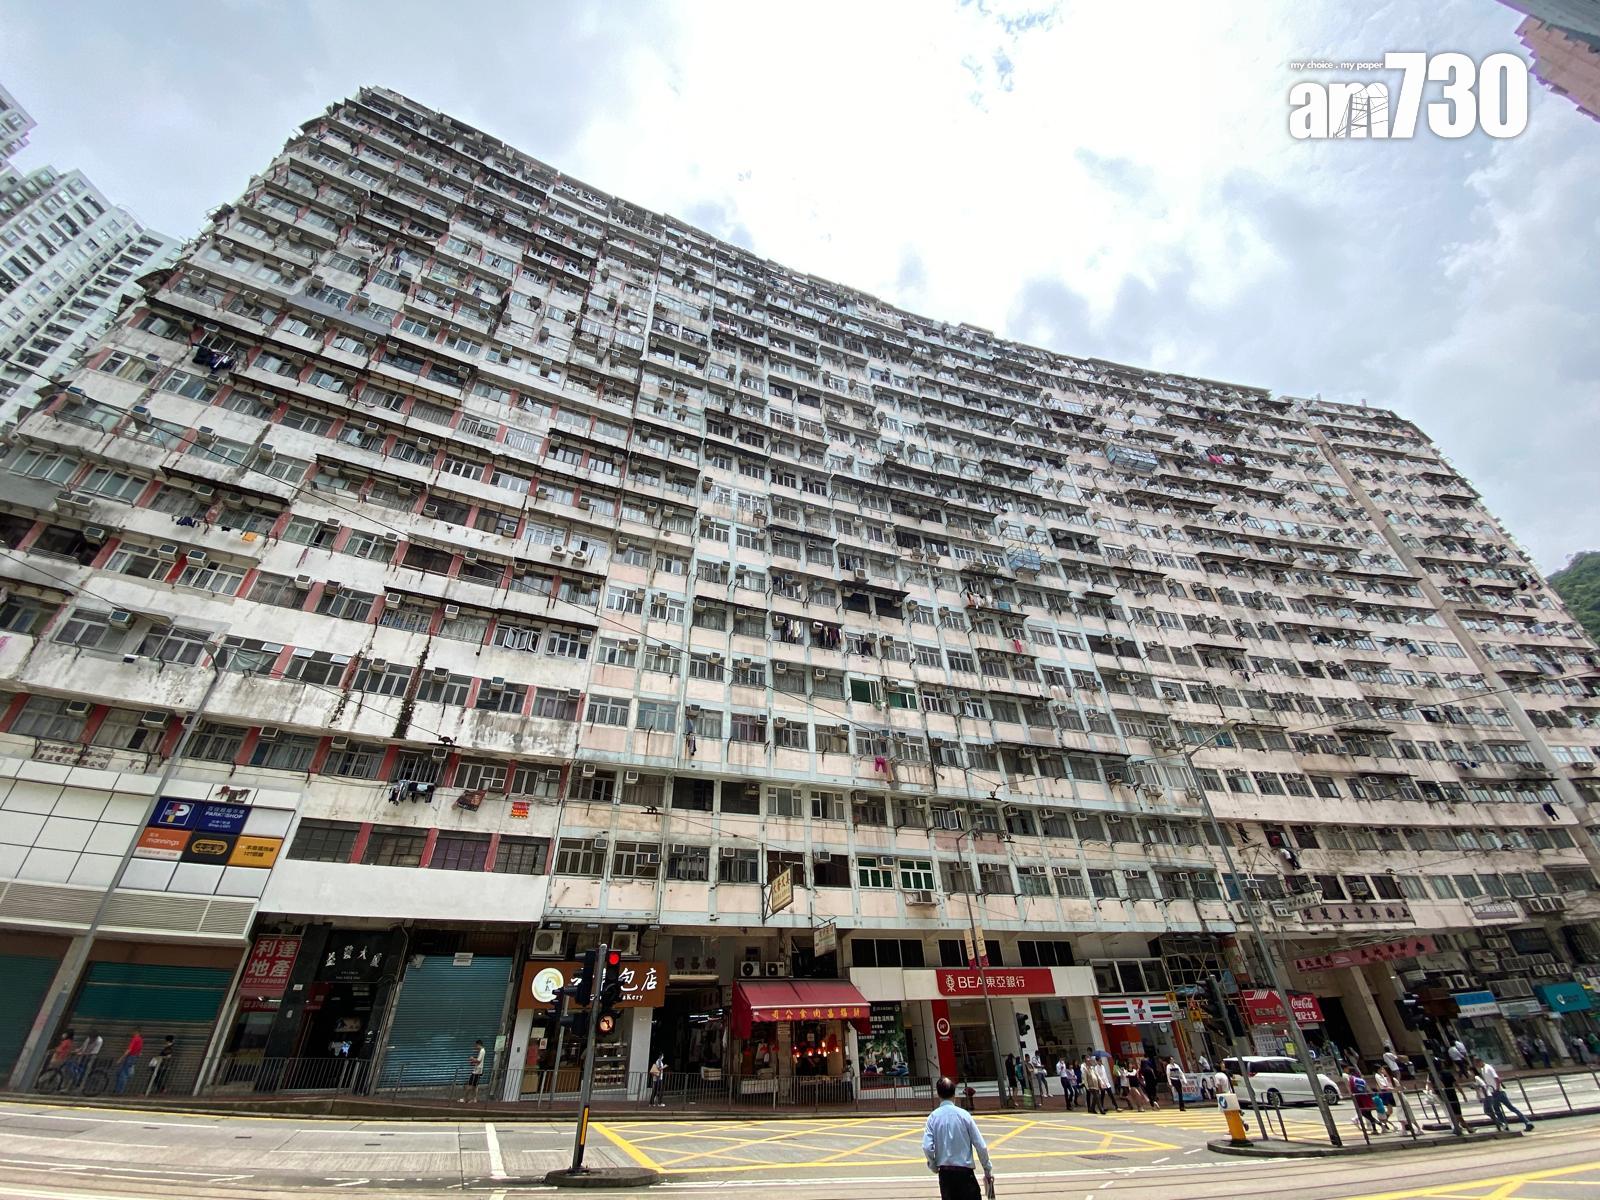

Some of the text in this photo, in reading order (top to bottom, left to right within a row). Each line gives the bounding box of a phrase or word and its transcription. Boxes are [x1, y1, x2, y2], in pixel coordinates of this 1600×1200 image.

[255, 940, 298, 958] 利達
[248, 959, 291, 977] 地產
[957, 977, 983, 989] BEA
[985, 975, 1026, 989] 東亞銀行
